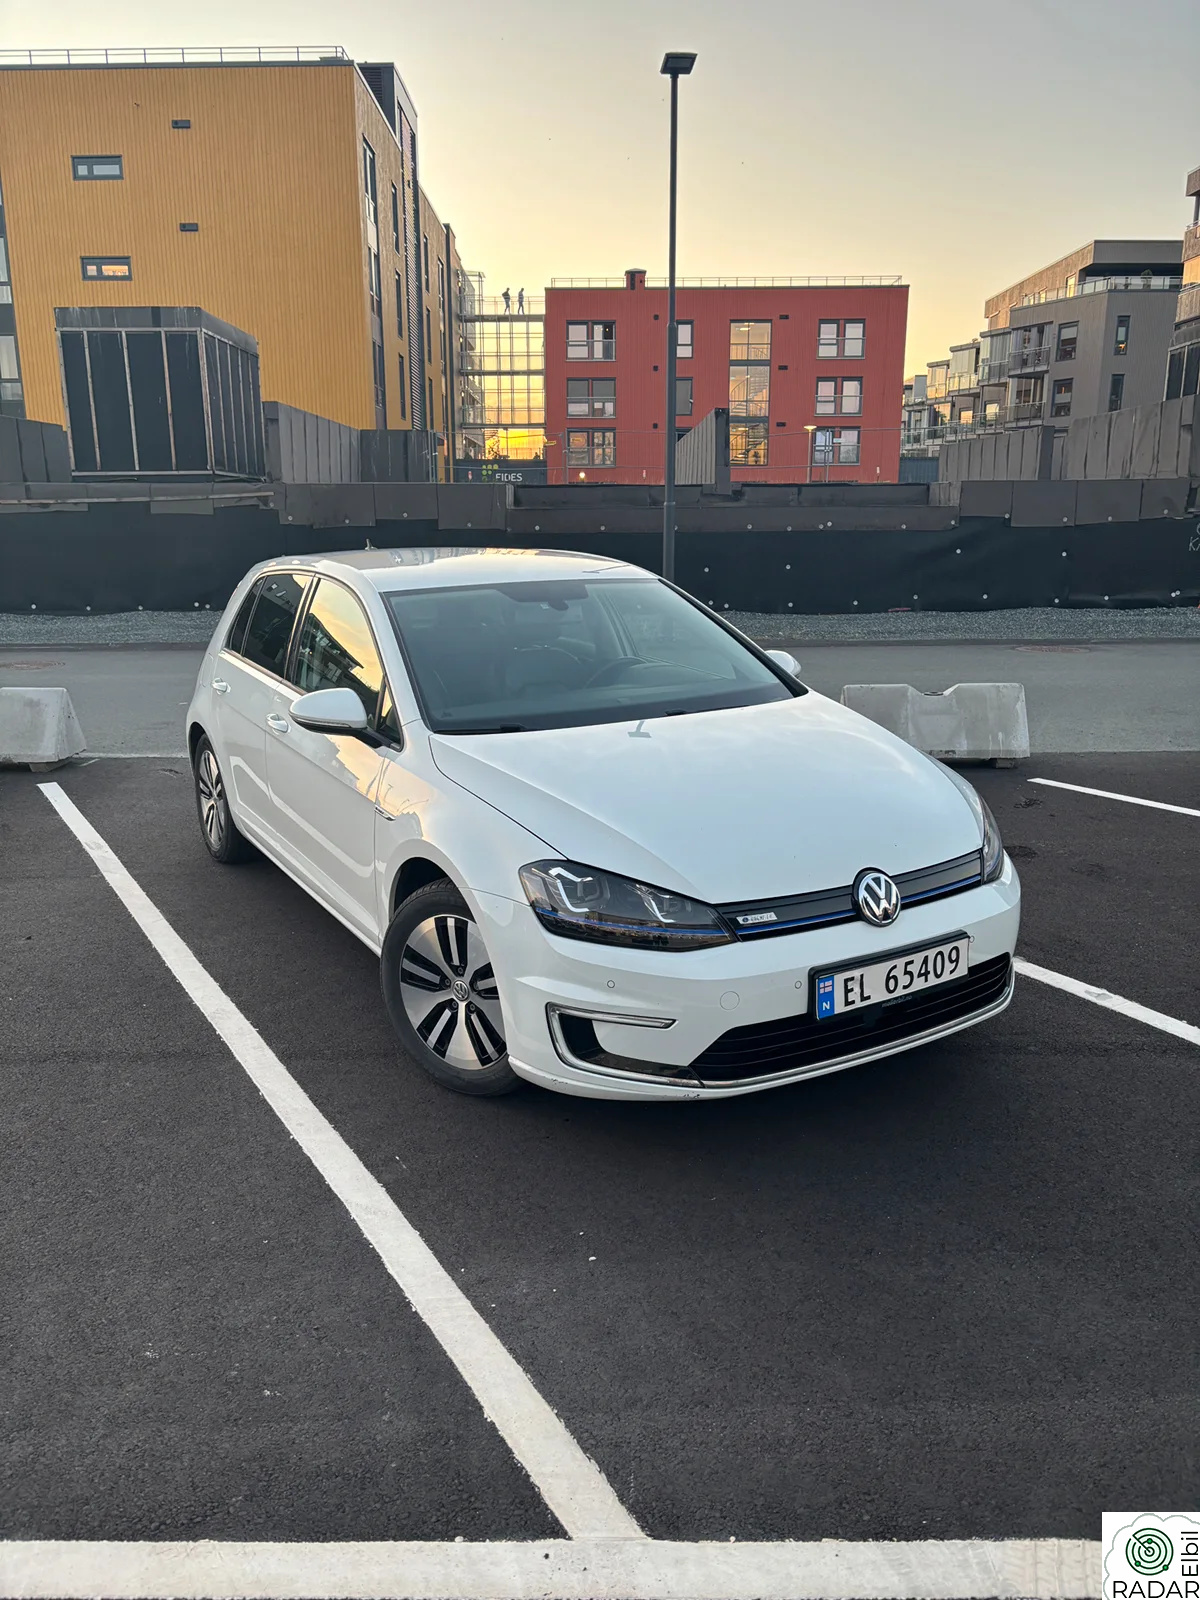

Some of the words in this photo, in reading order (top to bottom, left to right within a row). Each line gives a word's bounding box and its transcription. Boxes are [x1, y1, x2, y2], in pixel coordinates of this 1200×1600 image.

[495, 473, 523, 482] FIDES
[843, 973, 871, 1007] EL
[885, 945, 960, 994] 65409
[822, 1001, 831, 1011] N
